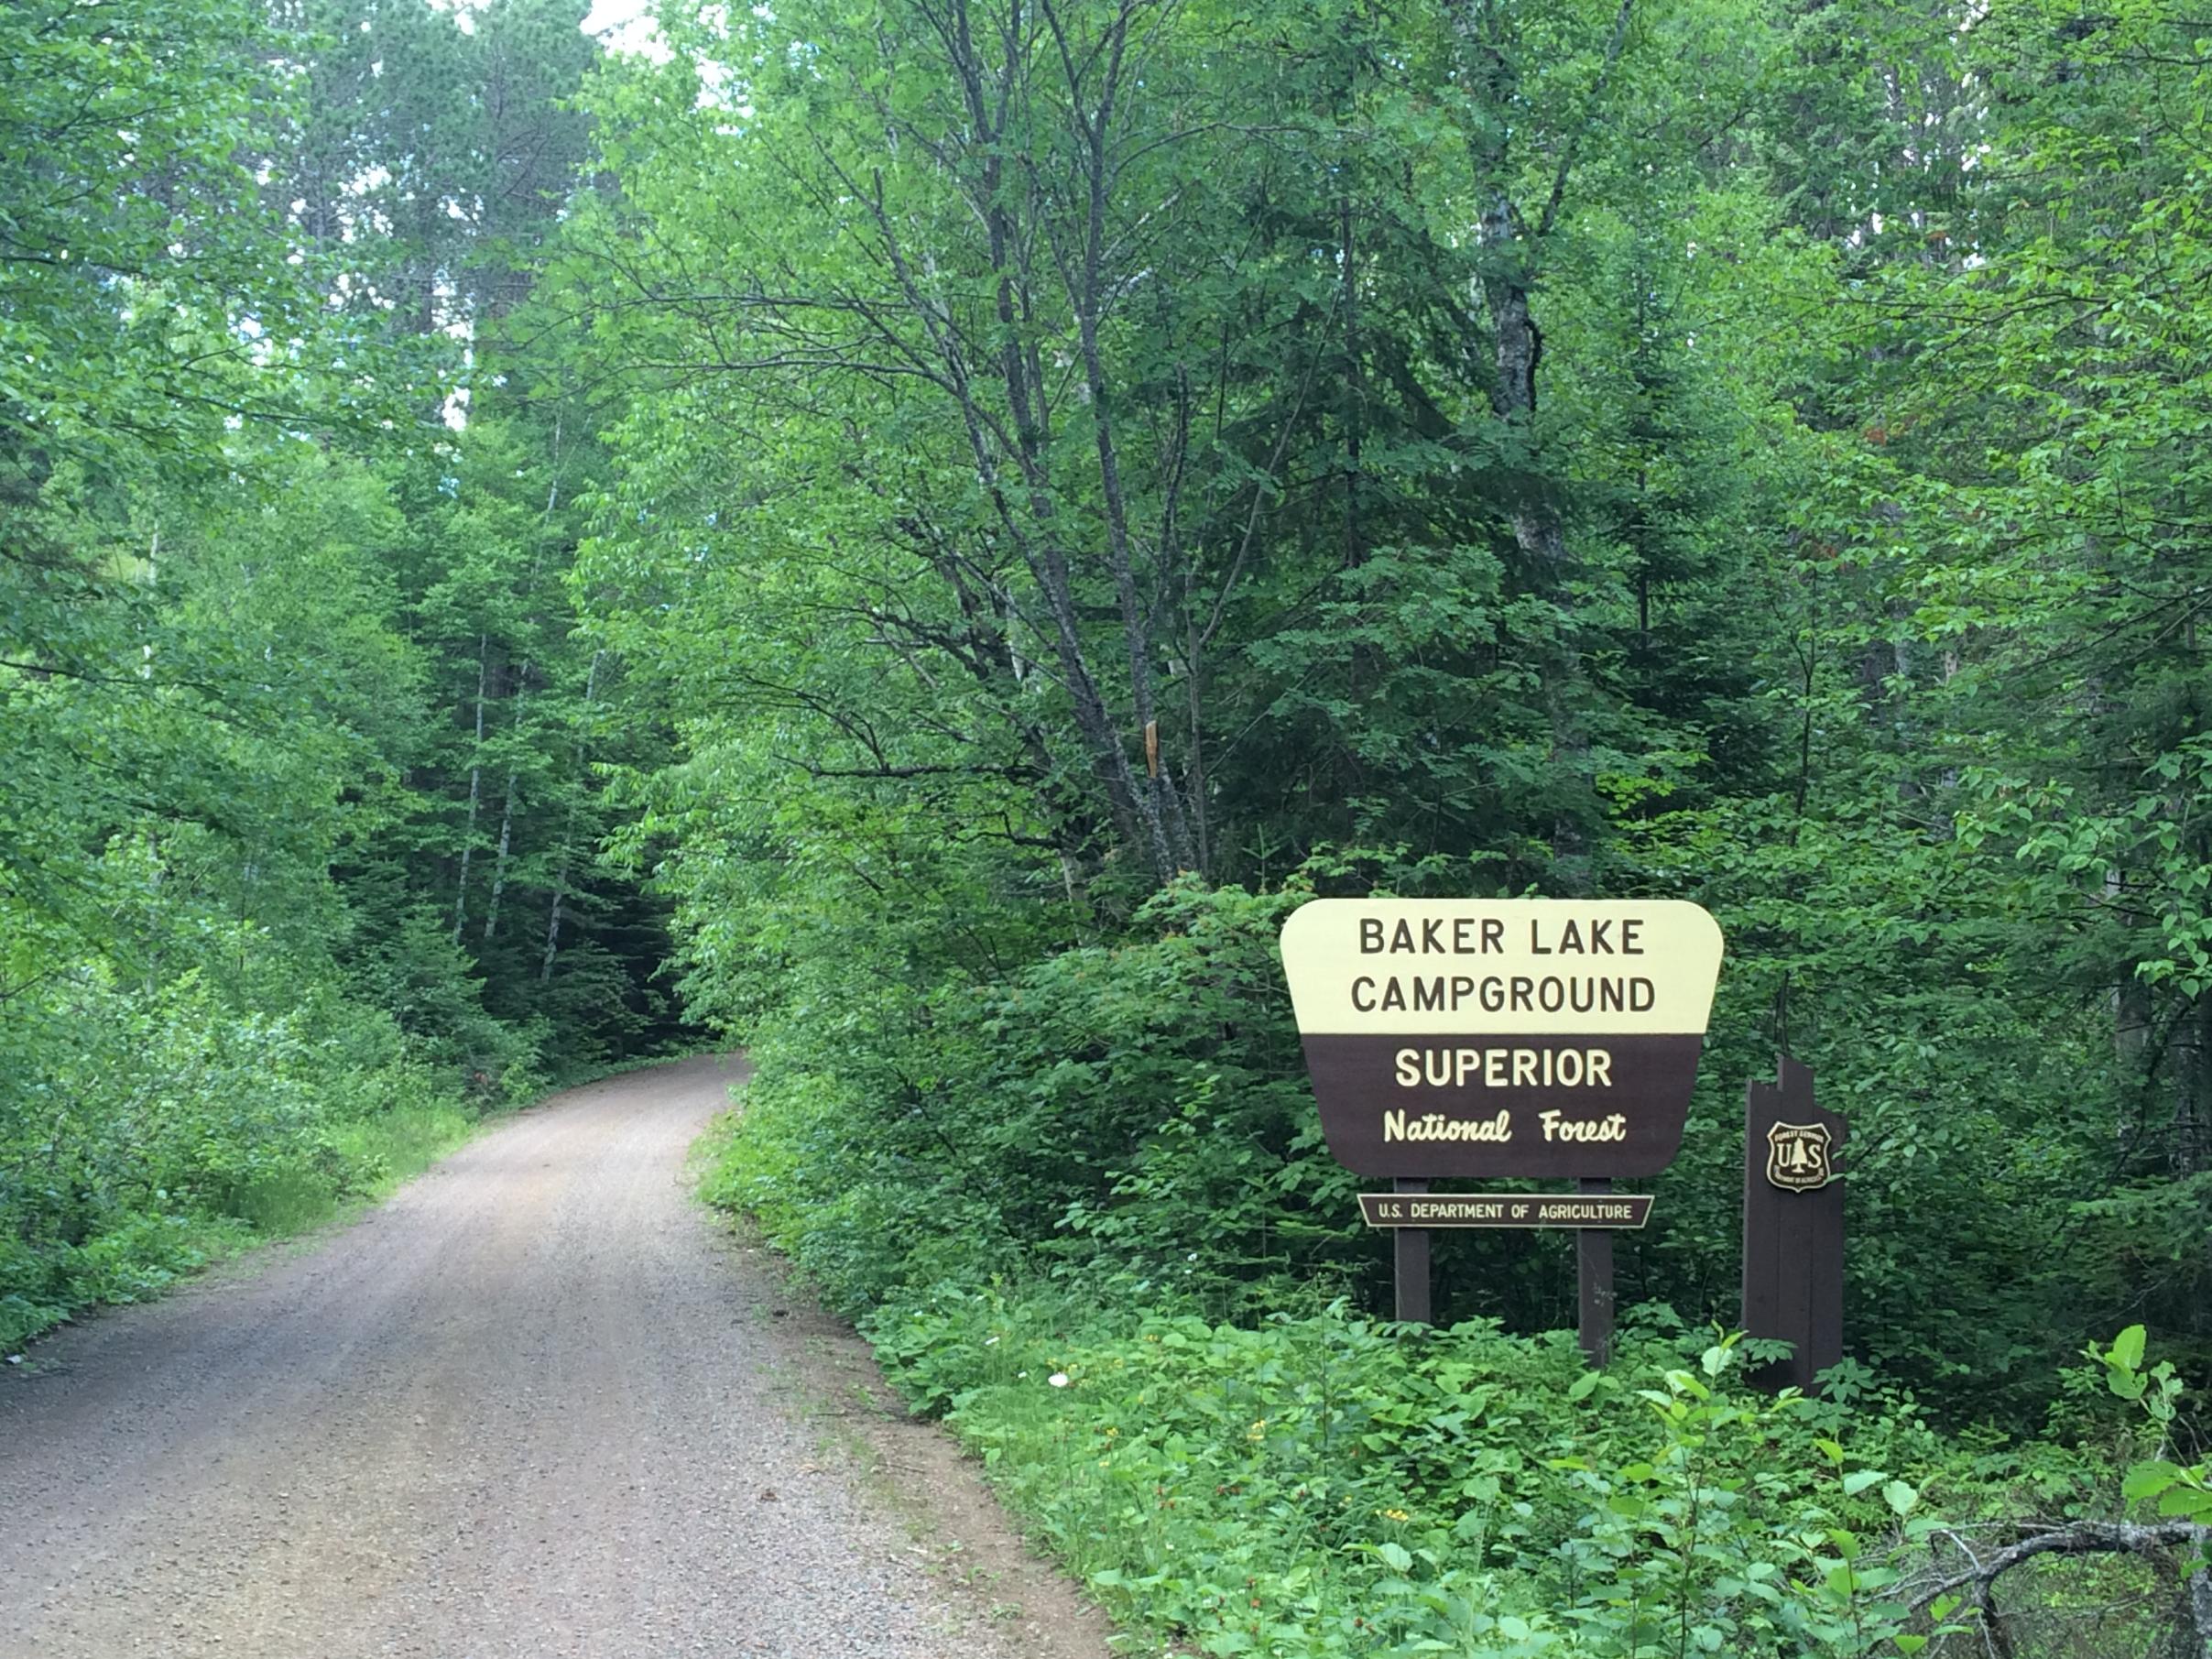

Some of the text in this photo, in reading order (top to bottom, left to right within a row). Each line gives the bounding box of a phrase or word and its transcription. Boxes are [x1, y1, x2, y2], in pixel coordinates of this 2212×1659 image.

[1360, 918, 1644, 955] BAKER LAKE
[1351, 977, 1656, 1012] CAMPGROUND
[1395, 1049, 1612, 1087] SUPERIOR
[1384, 1109, 1627, 1142] National Forest
[1378, 1203, 1633, 1219] U.S. DEPARTMENT OF AGRICULTURE
